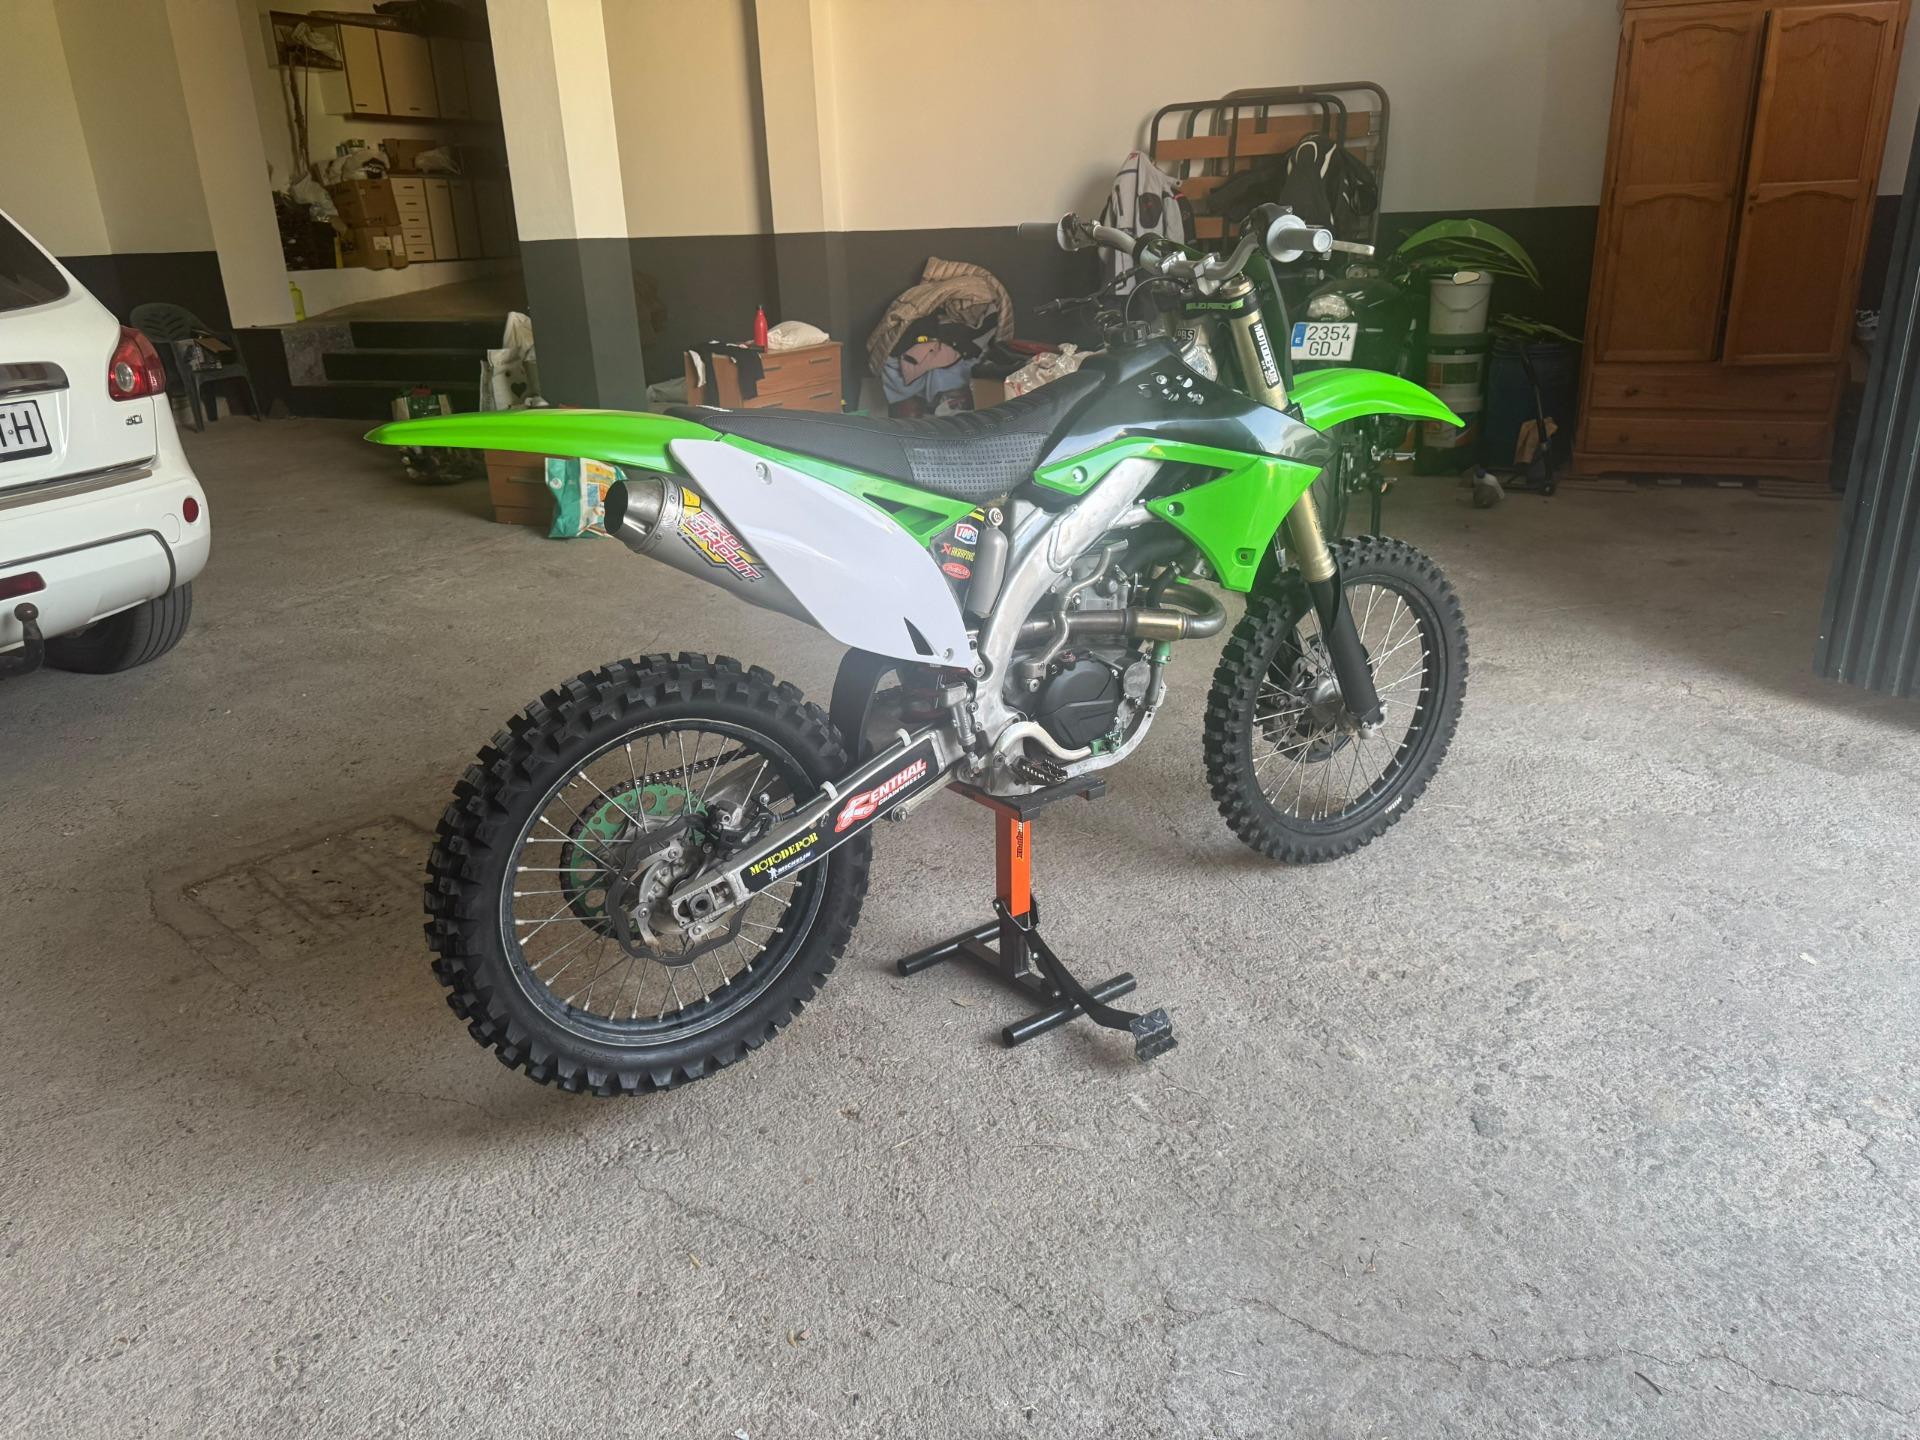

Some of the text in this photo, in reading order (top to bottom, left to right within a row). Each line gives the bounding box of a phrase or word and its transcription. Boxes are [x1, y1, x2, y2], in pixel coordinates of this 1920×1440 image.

[1307, 325, 1351, 341] 2354
[1308, 341, 1343, 356] GDJ
[682, 519, 765, 579] CIRCUIT
[749, 832, 818, 876] MOTODEPOR
